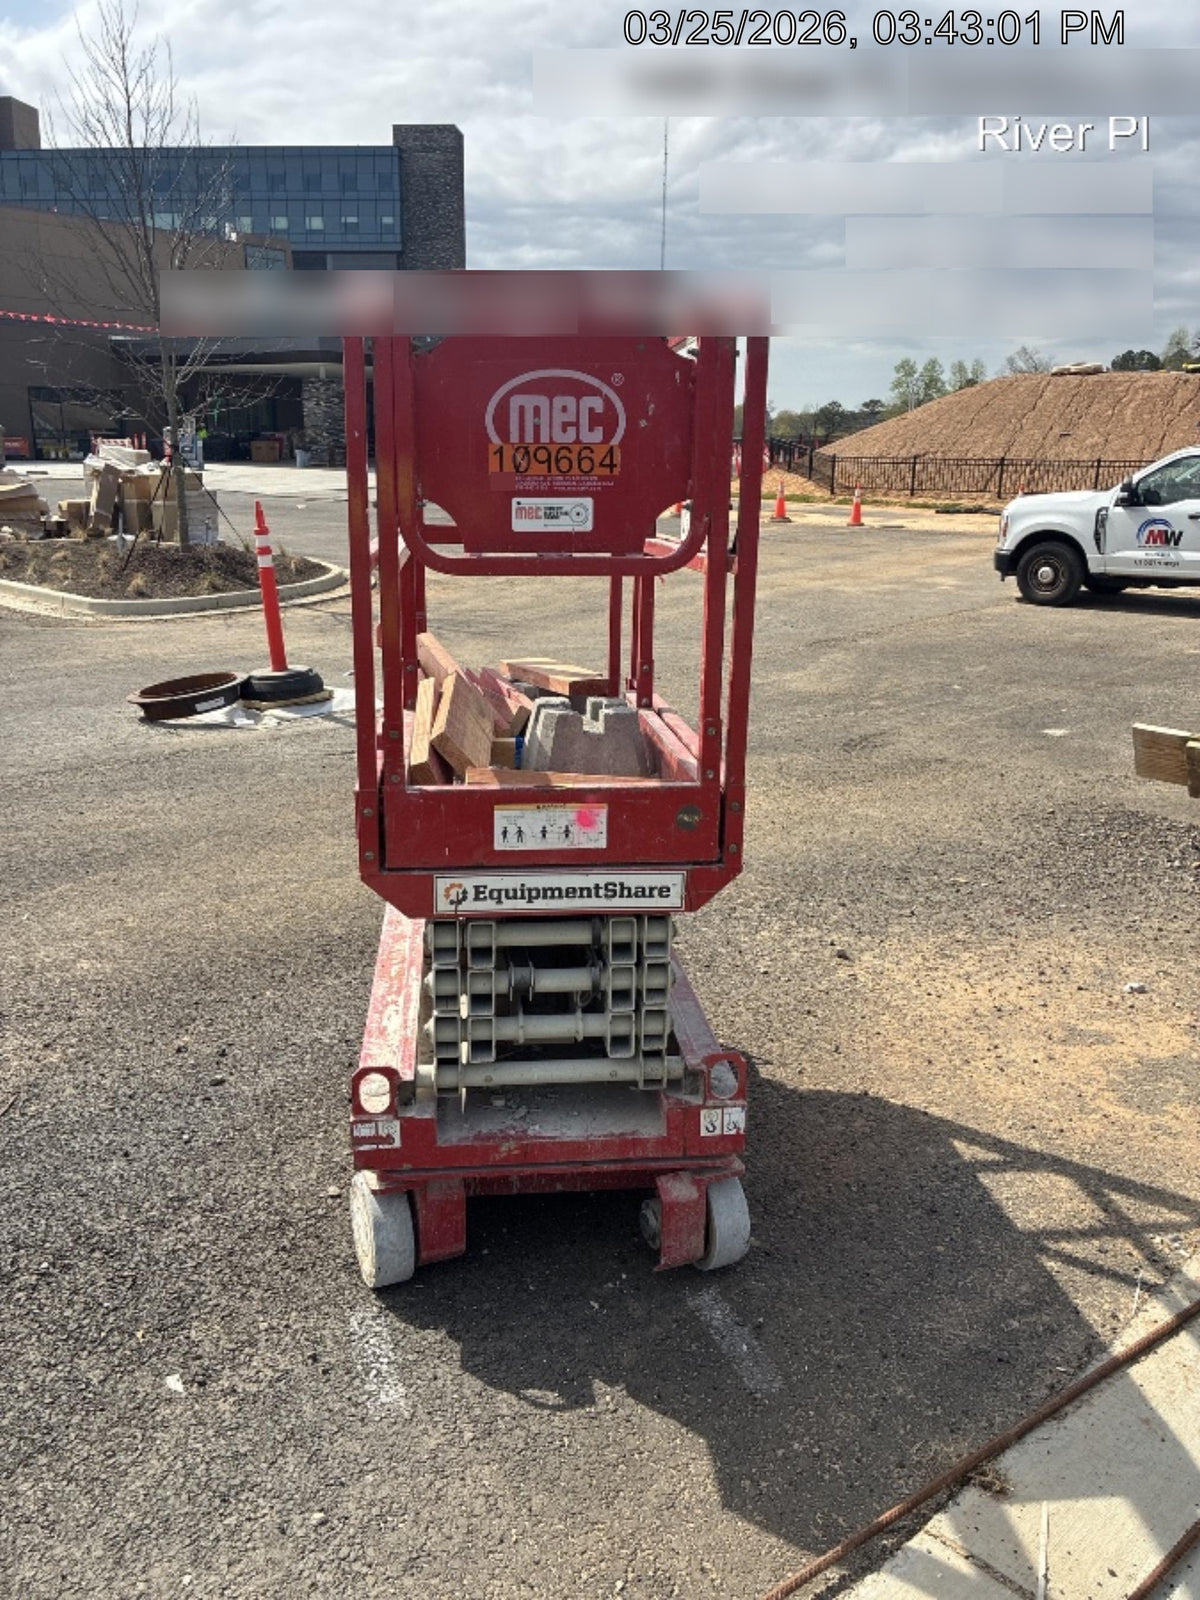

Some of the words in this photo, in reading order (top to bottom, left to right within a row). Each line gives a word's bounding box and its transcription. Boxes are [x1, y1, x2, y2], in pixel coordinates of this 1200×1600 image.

[493, 446, 617, 473] 109664
[1145, 530, 1183, 546] MW
[472, 882, 671, 904] EquipmentShare
